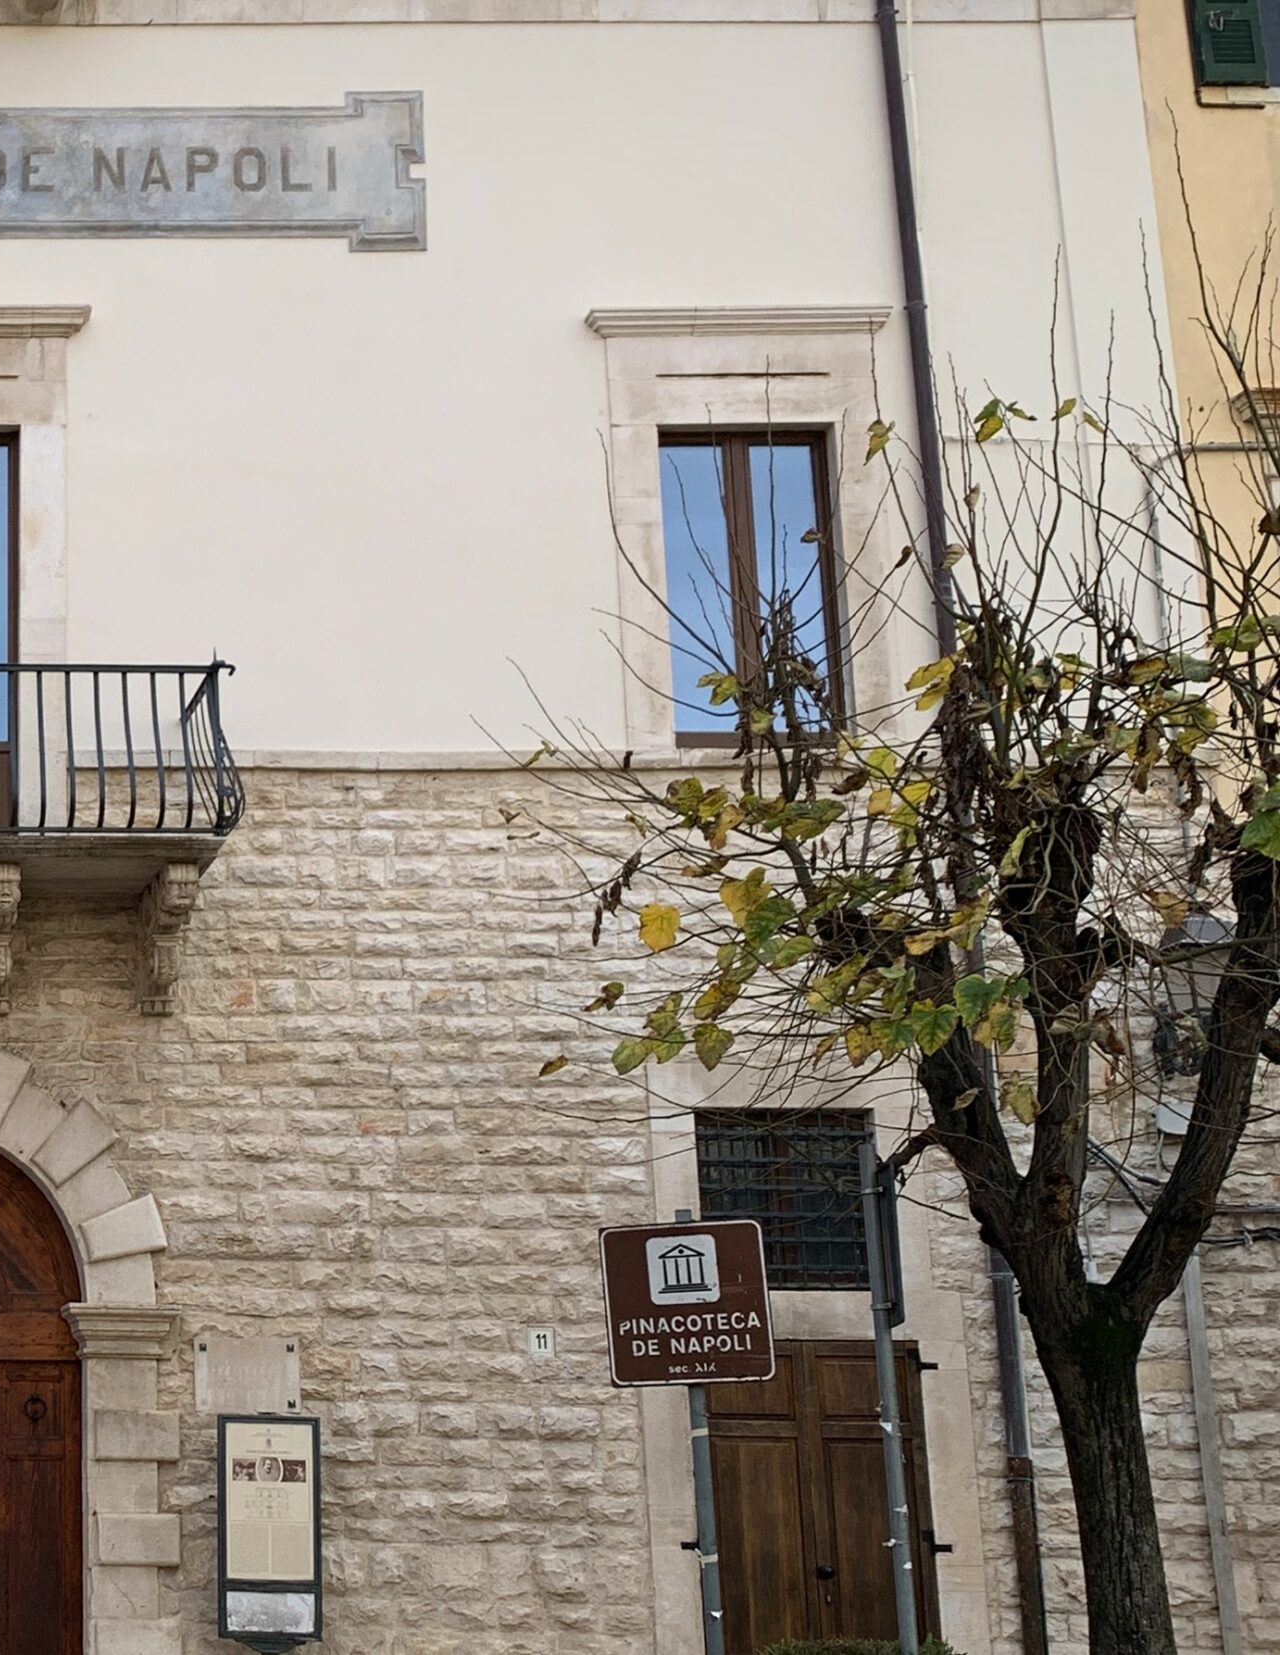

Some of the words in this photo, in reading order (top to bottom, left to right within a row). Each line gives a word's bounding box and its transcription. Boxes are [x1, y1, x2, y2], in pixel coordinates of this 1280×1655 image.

[92, 145, 337, 193] NAPOLI
[619, 1311, 761, 1336] PINACOTECA
[535, 1333, 547, 1349] 11
[631, 1339, 661, 1357] DE
[670, 1334, 752, 1354] NAPOLI
